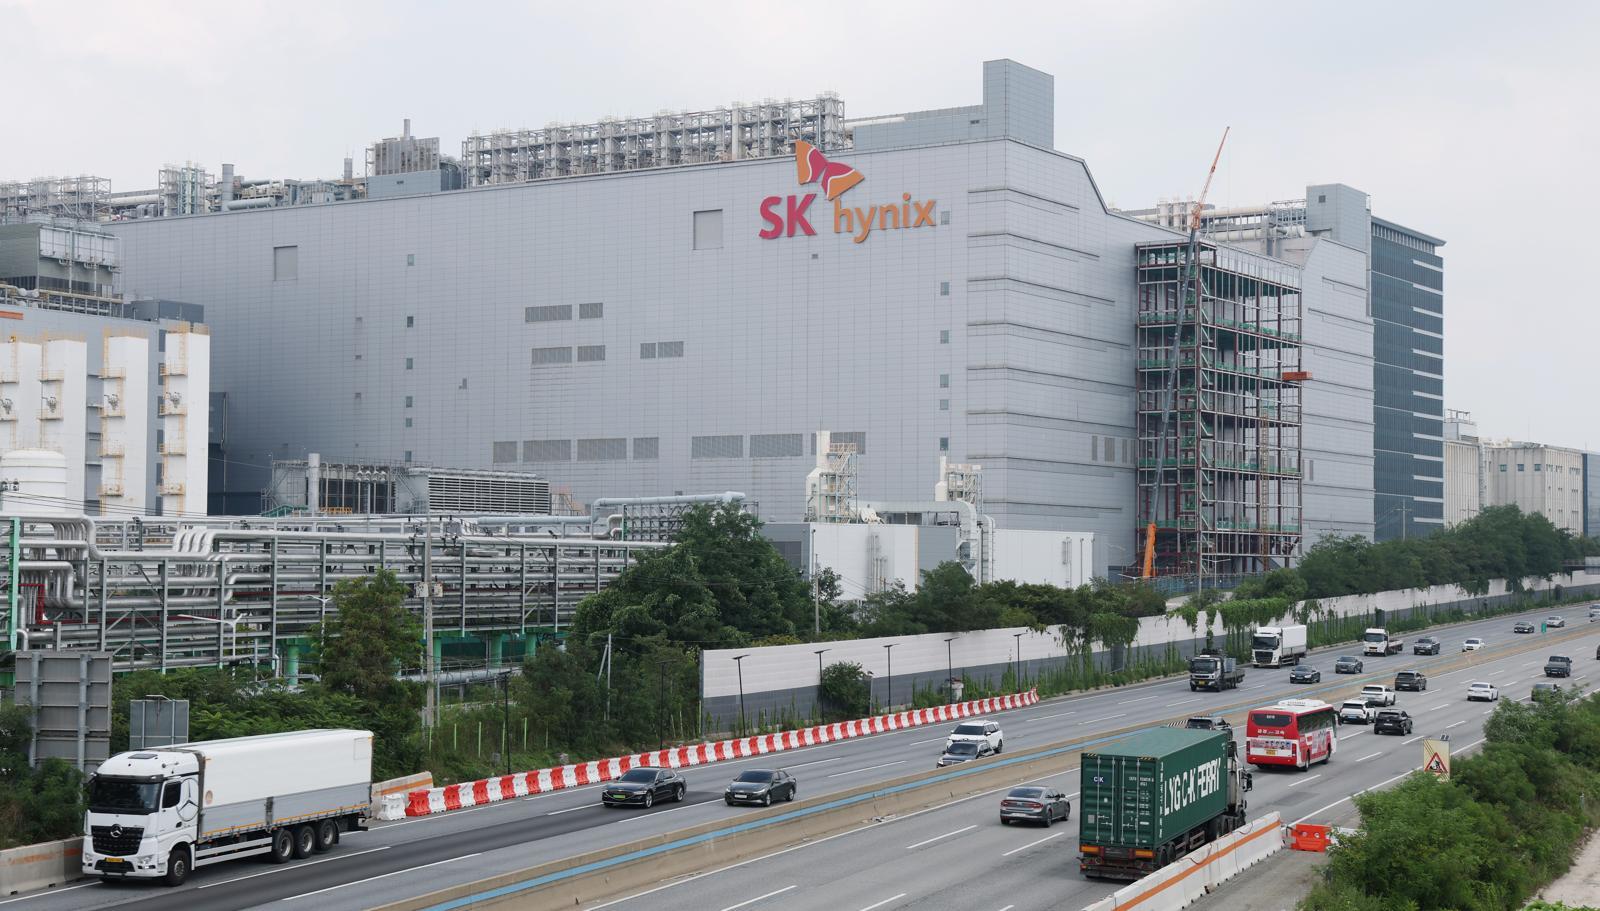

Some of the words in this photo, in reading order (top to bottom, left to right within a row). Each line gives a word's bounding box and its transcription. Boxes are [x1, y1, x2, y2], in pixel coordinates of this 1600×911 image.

[758, 193, 817, 239] SK
[833, 192, 937, 244] hynix
[1164, 774, 1181, 816] LYG
[1197, 757, 1221, 800] FERRY
